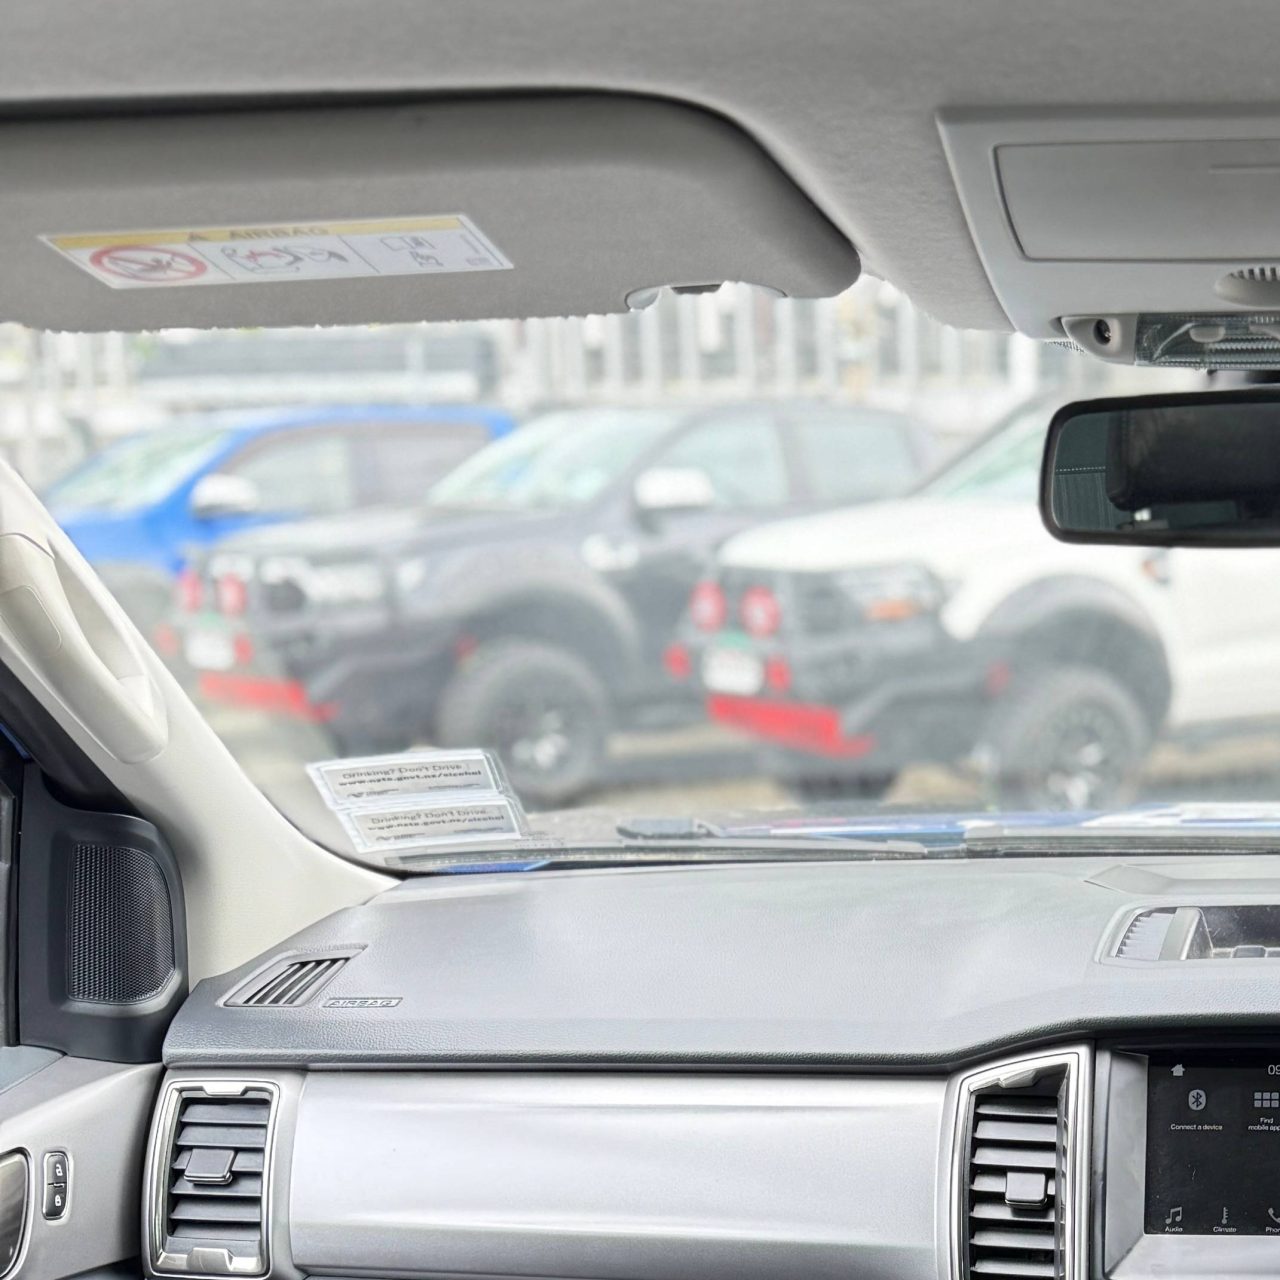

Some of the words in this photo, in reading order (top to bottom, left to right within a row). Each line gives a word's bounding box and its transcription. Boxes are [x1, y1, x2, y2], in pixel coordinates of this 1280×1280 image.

[342, 768, 395, 780] Drinking?
[398, 766, 429, 774] Don't
[371, 813, 421, 824] Drinking?
